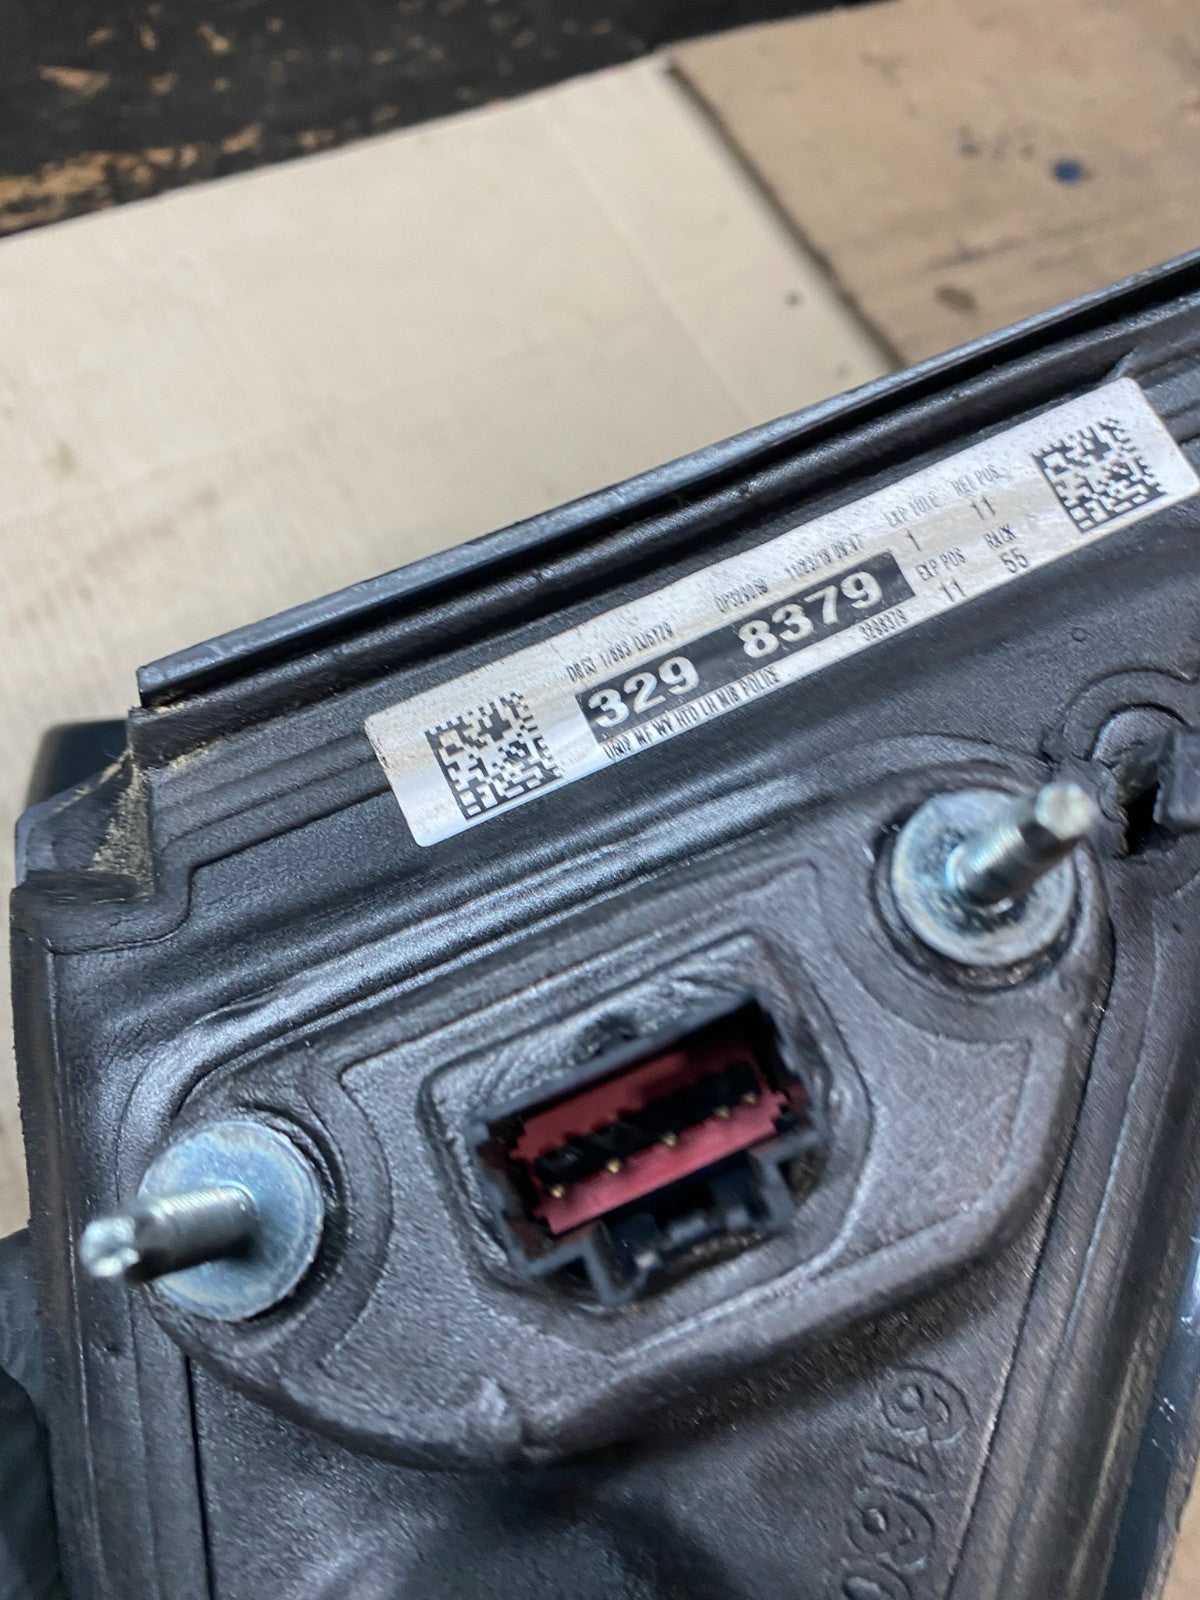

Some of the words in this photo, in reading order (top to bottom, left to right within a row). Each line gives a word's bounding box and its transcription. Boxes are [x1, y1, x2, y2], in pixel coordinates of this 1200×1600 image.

[970, 496, 997, 521] 11
[915, 558, 940, 582] EXP
[939, 547, 967, 571] POS
[999, 548, 1030, 574] 55
[939, 577, 967, 603] 11
[588, 656, 700, 728] 329
[738, 571, 883, 658] 8379
